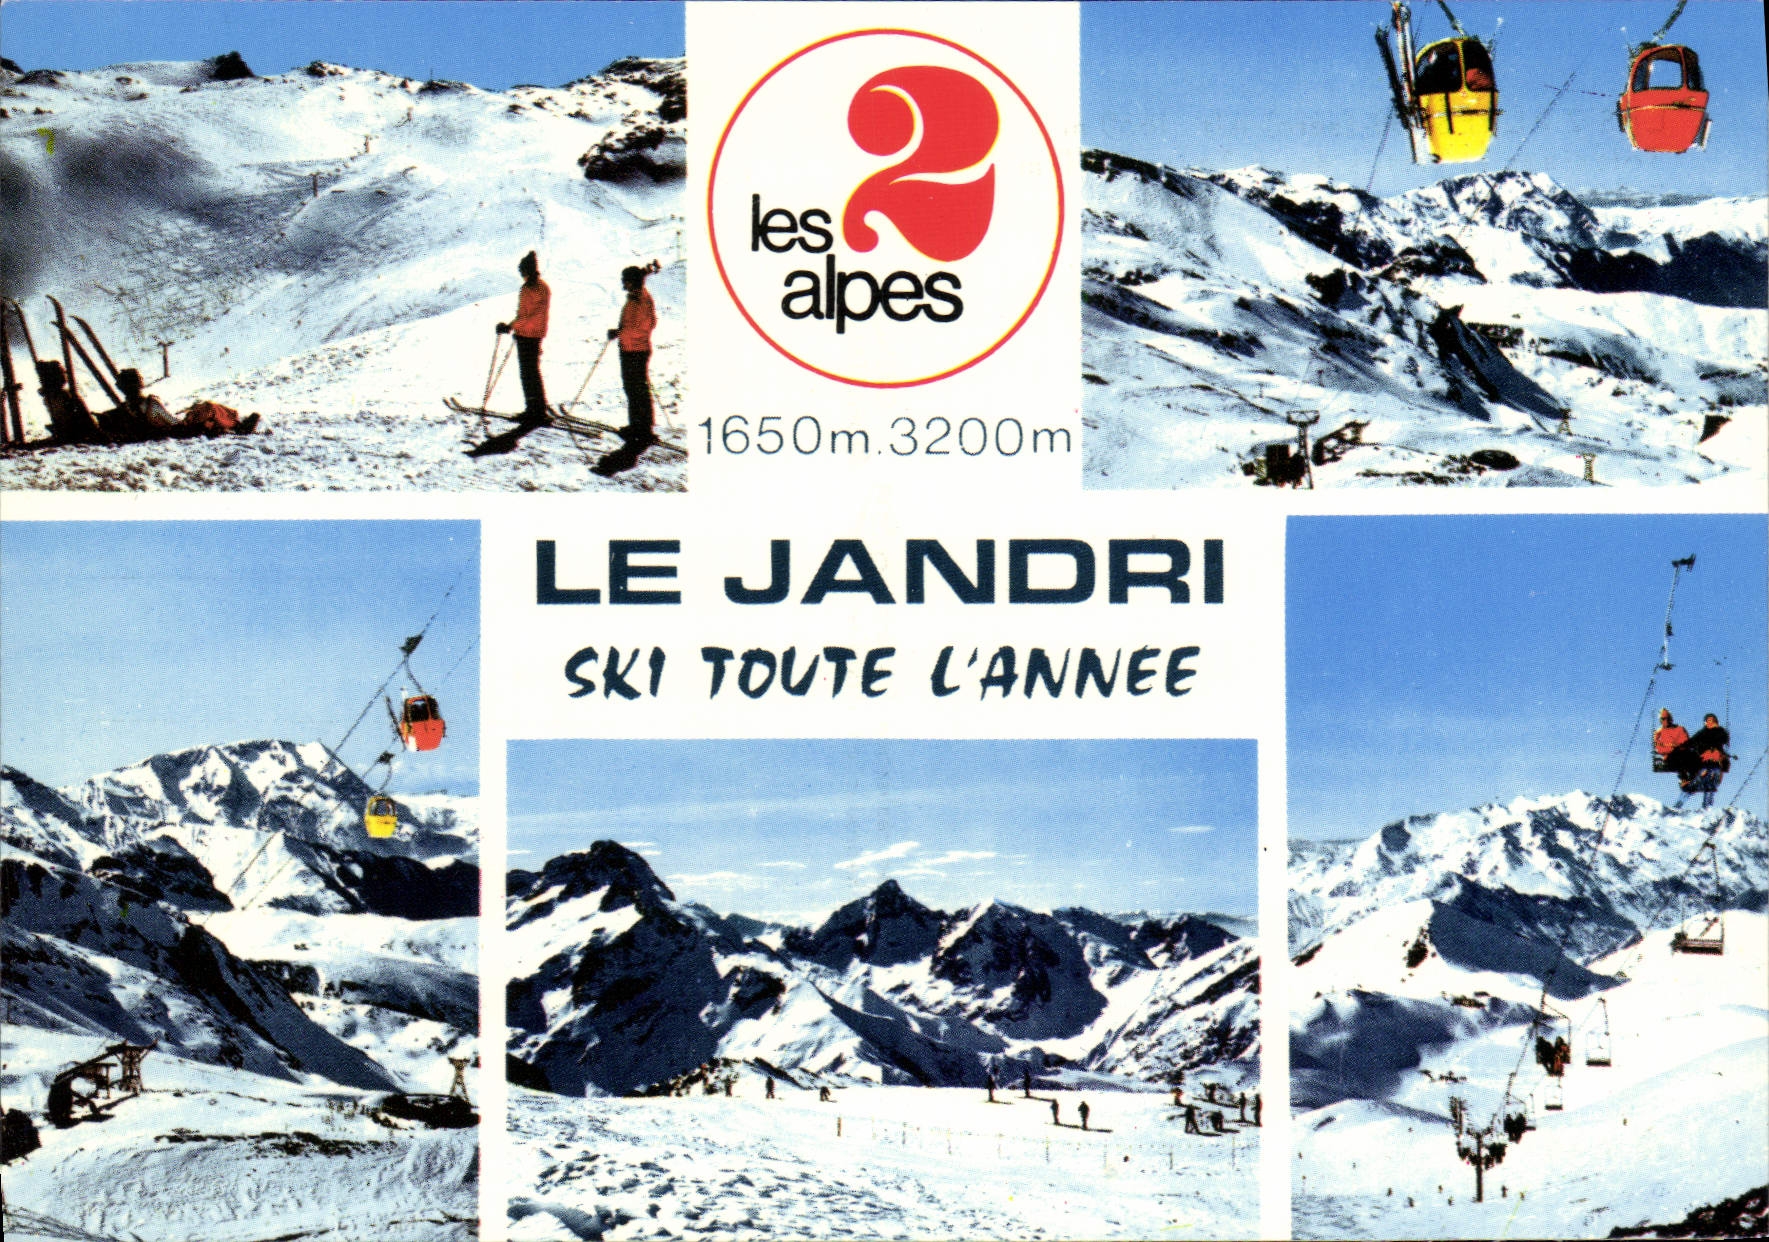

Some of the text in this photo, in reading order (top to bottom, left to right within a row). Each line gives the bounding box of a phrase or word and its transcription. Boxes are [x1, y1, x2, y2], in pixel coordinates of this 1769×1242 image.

[843, 65, 1000, 262] 2
[751, 193, 834, 254] les
[781, 253, 963, 334] alpes
[536, 538, 1224, 605] LE JANDRI
[564, 645, 666, 699] SKI
[701, 646, 896, 699] TOUTE
